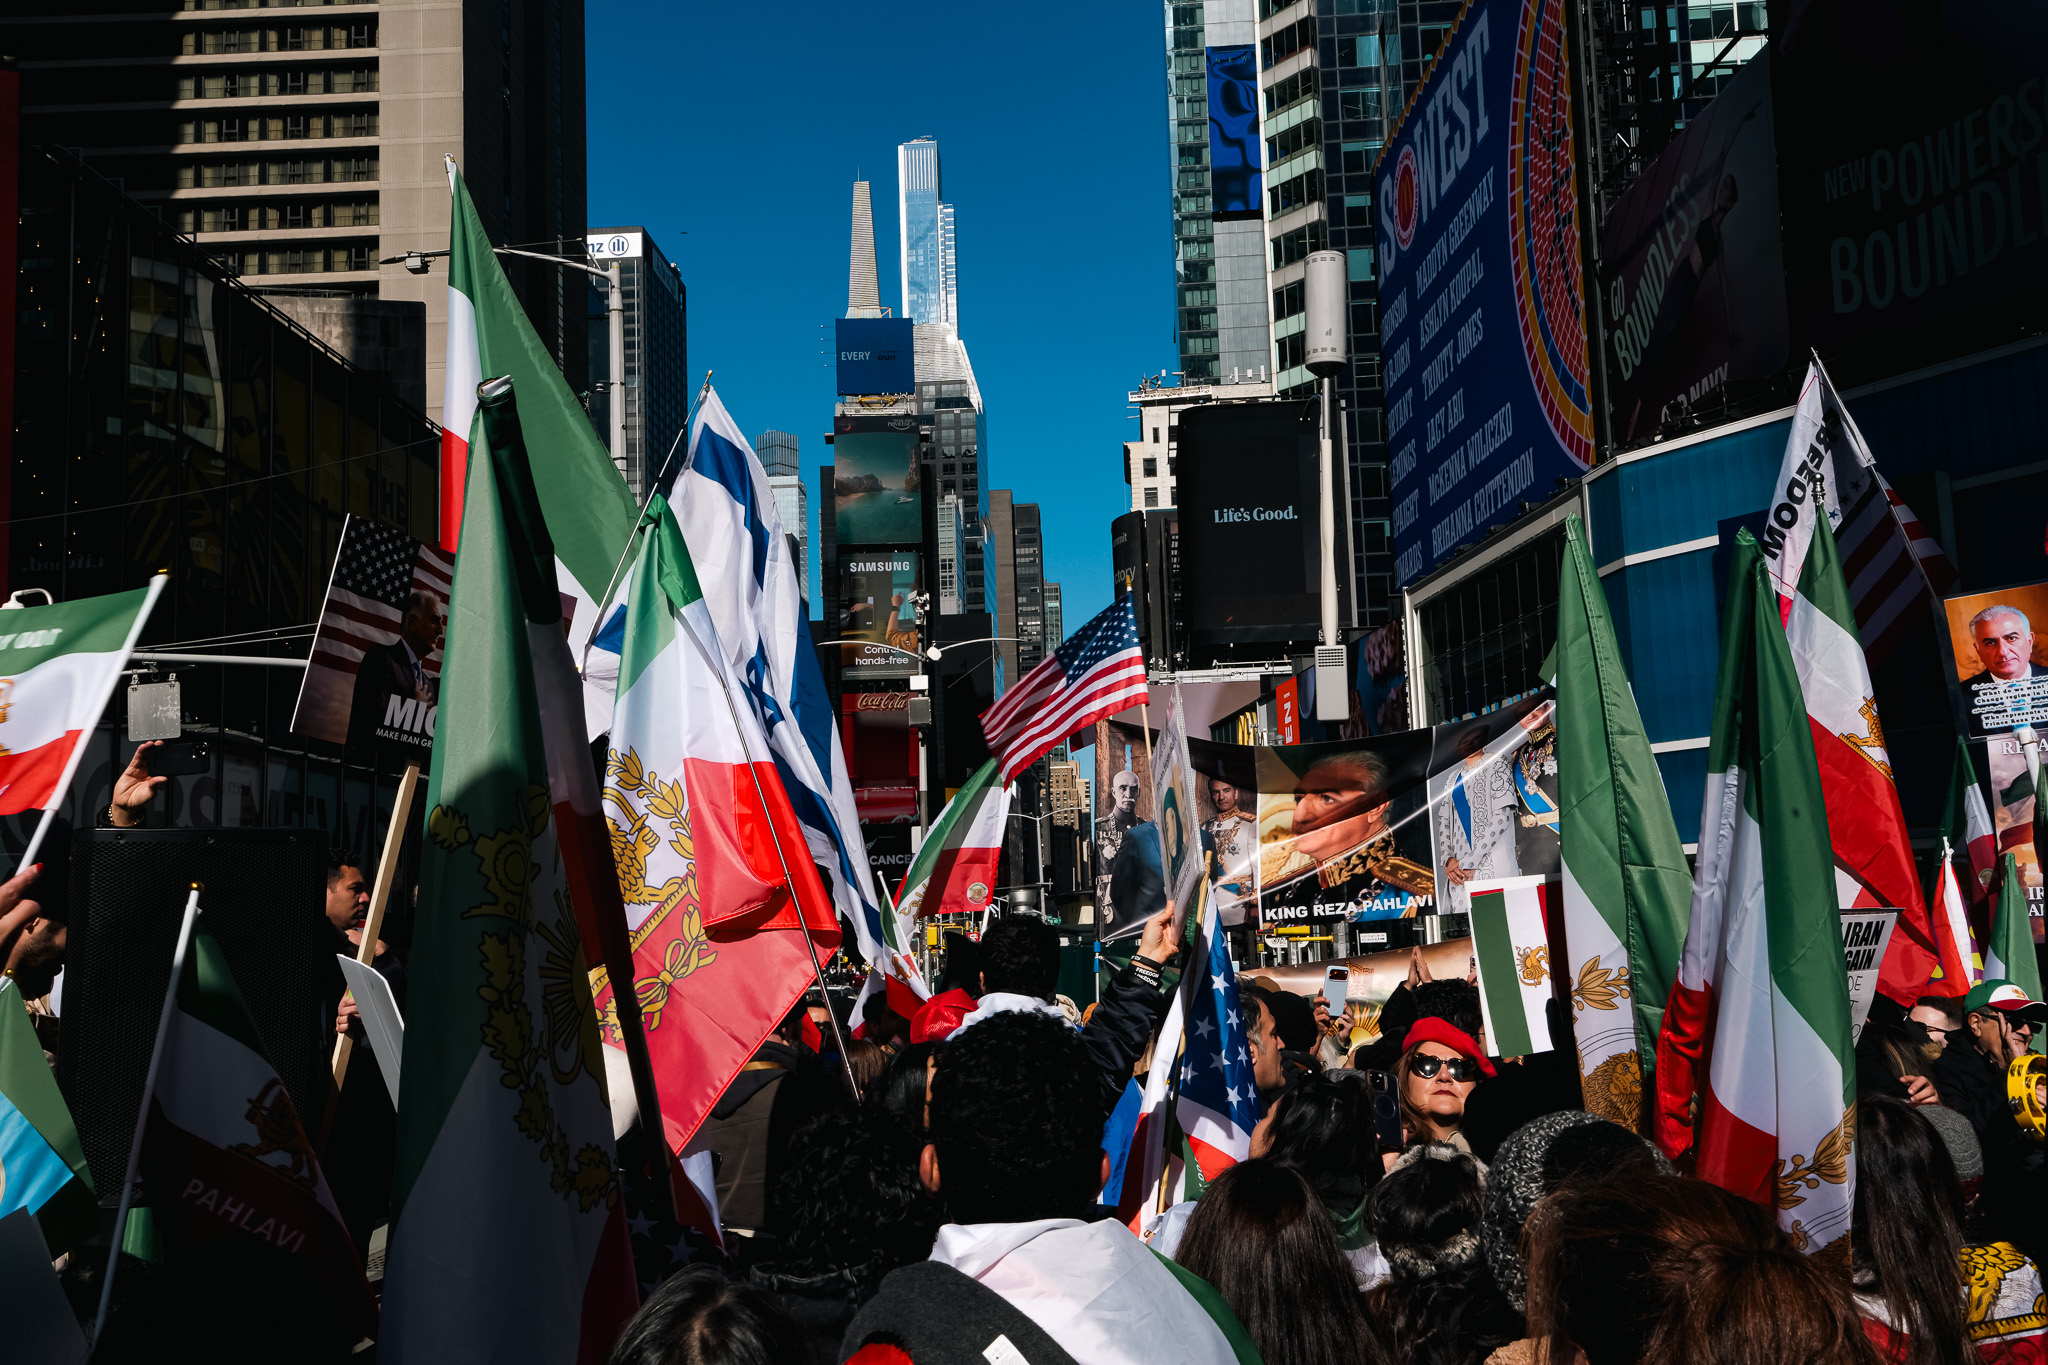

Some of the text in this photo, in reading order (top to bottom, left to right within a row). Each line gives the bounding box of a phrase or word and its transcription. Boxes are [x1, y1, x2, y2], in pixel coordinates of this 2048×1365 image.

[1413, 7, 1490, 224] WEST
[1823, 77, 2048, 212] NEW POWERS
[1449, 165, 1495, 258] GREENWAY
[1420, 247, 1484, 351] ASHLYN KOUPAL
[1610, 275, 1625, 322] GO
[1613, 172, 1699, 382] BOUNDLESS
[841, 351, 871, 361] EVERY
[1421, 307, 1484, 402] TRINITY JONES
[1690, 361, 1728, 404] NAVY
[1426, 406, 1446, 454] JACY
[1214, 505, 1299, 524] Life's Good.
[1431, 447, 1535, 559] BRIHANNA CRITTENDON
[850, 561, 910, 573] SAMSUNG
[855, 656, 909, 666] hands-free
[857, 692, 910, 711] Coca-Cola
[375, 727, 400, 740] MAKE
[400, 733, 420, 746] IRAN
[869, 851, 917, 865] CANCE
[1265, 894, 1433, 921] KING REZA PAHLAVI
[181, 1177, 306, 1255] PAHLAVI
